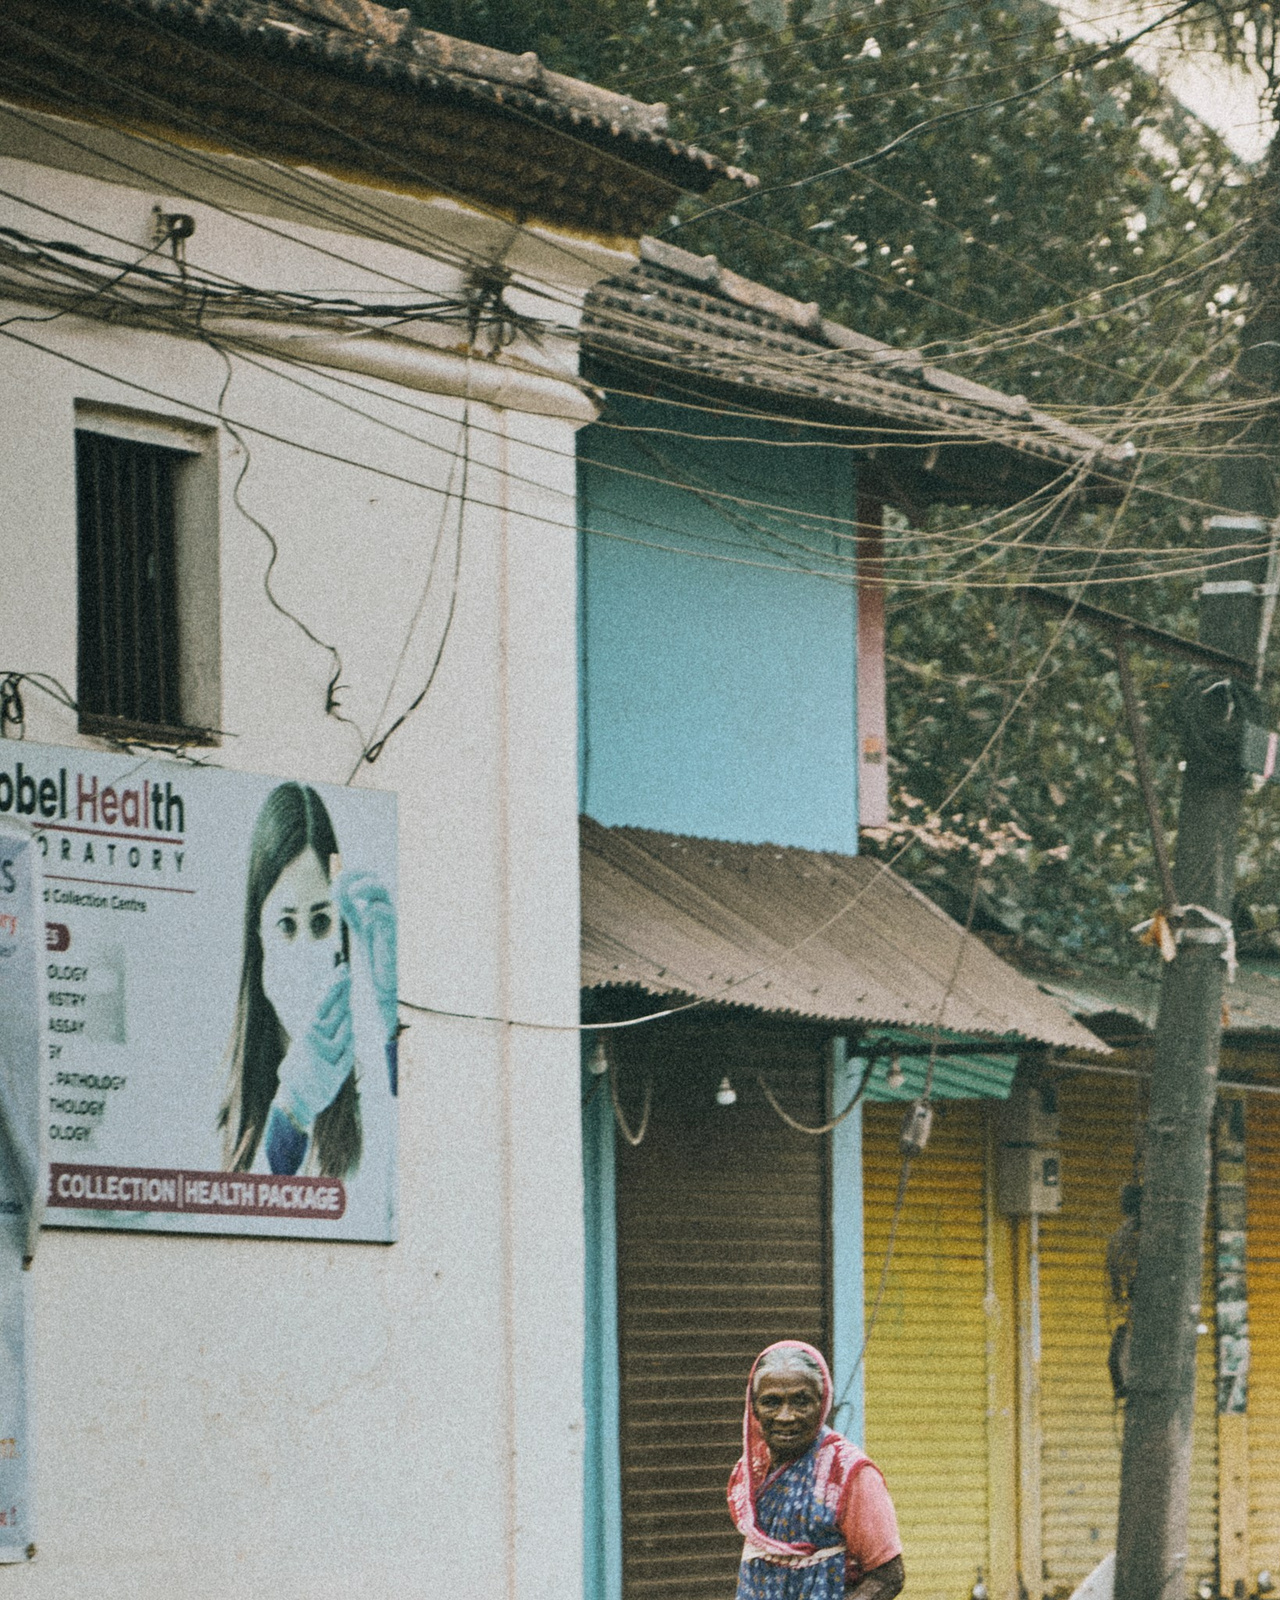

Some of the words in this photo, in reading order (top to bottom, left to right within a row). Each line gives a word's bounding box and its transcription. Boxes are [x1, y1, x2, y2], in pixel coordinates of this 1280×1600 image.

[77, 773, 185, 832] Health
[53, 889, 109, 908] Collection
[111, 895, 147, 912] Centre
[56, 1072, 126, 1090] PATHOLOGY
[57, 1173, 176, 1203] COLLECTION
[185, 1180, 255, 1206] HEALTH
[258, 1183, 340, 1211] PACKAGE
